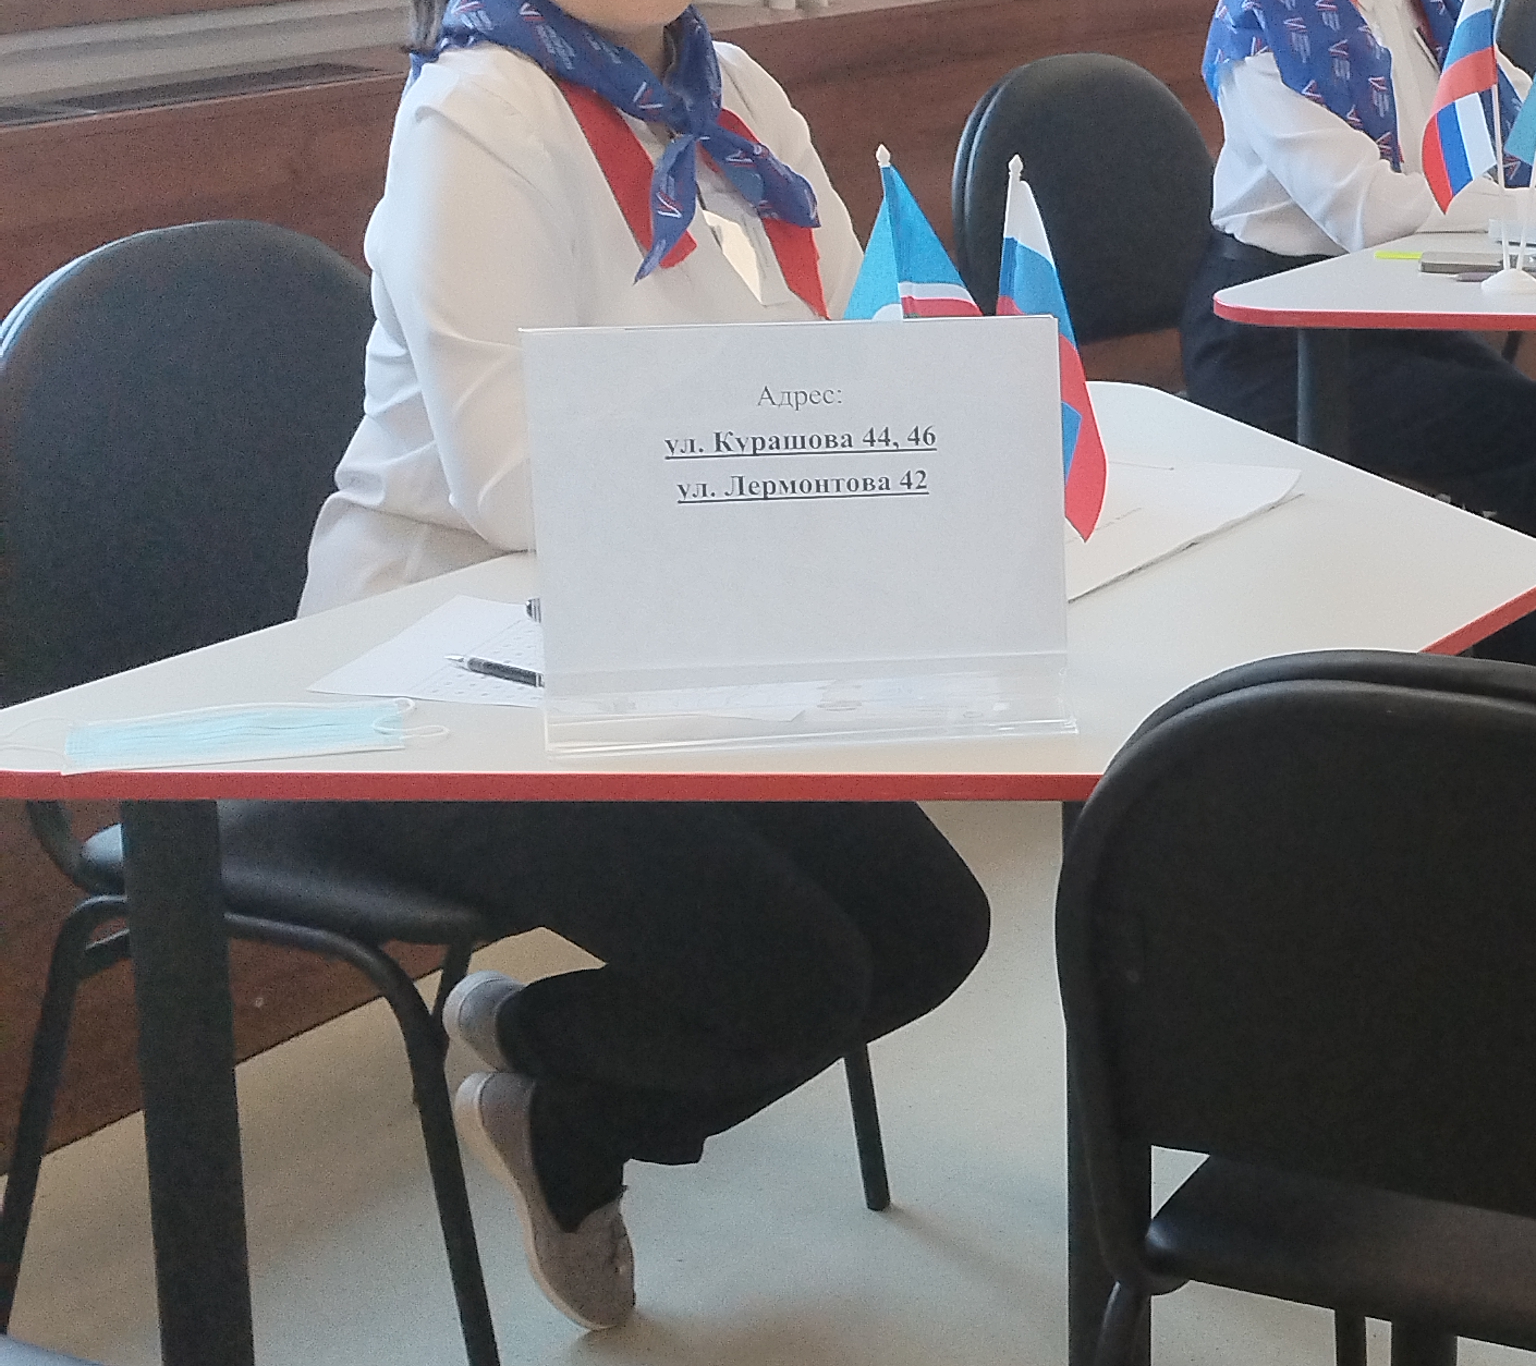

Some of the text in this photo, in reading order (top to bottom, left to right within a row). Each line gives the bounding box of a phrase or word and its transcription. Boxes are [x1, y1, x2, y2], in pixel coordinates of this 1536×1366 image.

[757, 385, 843, 411] Адрес:
[664, 424, 937, 457] ул. Курашова 44, 46
[677, 470, 928, 501] ул. Лермонтова 42
